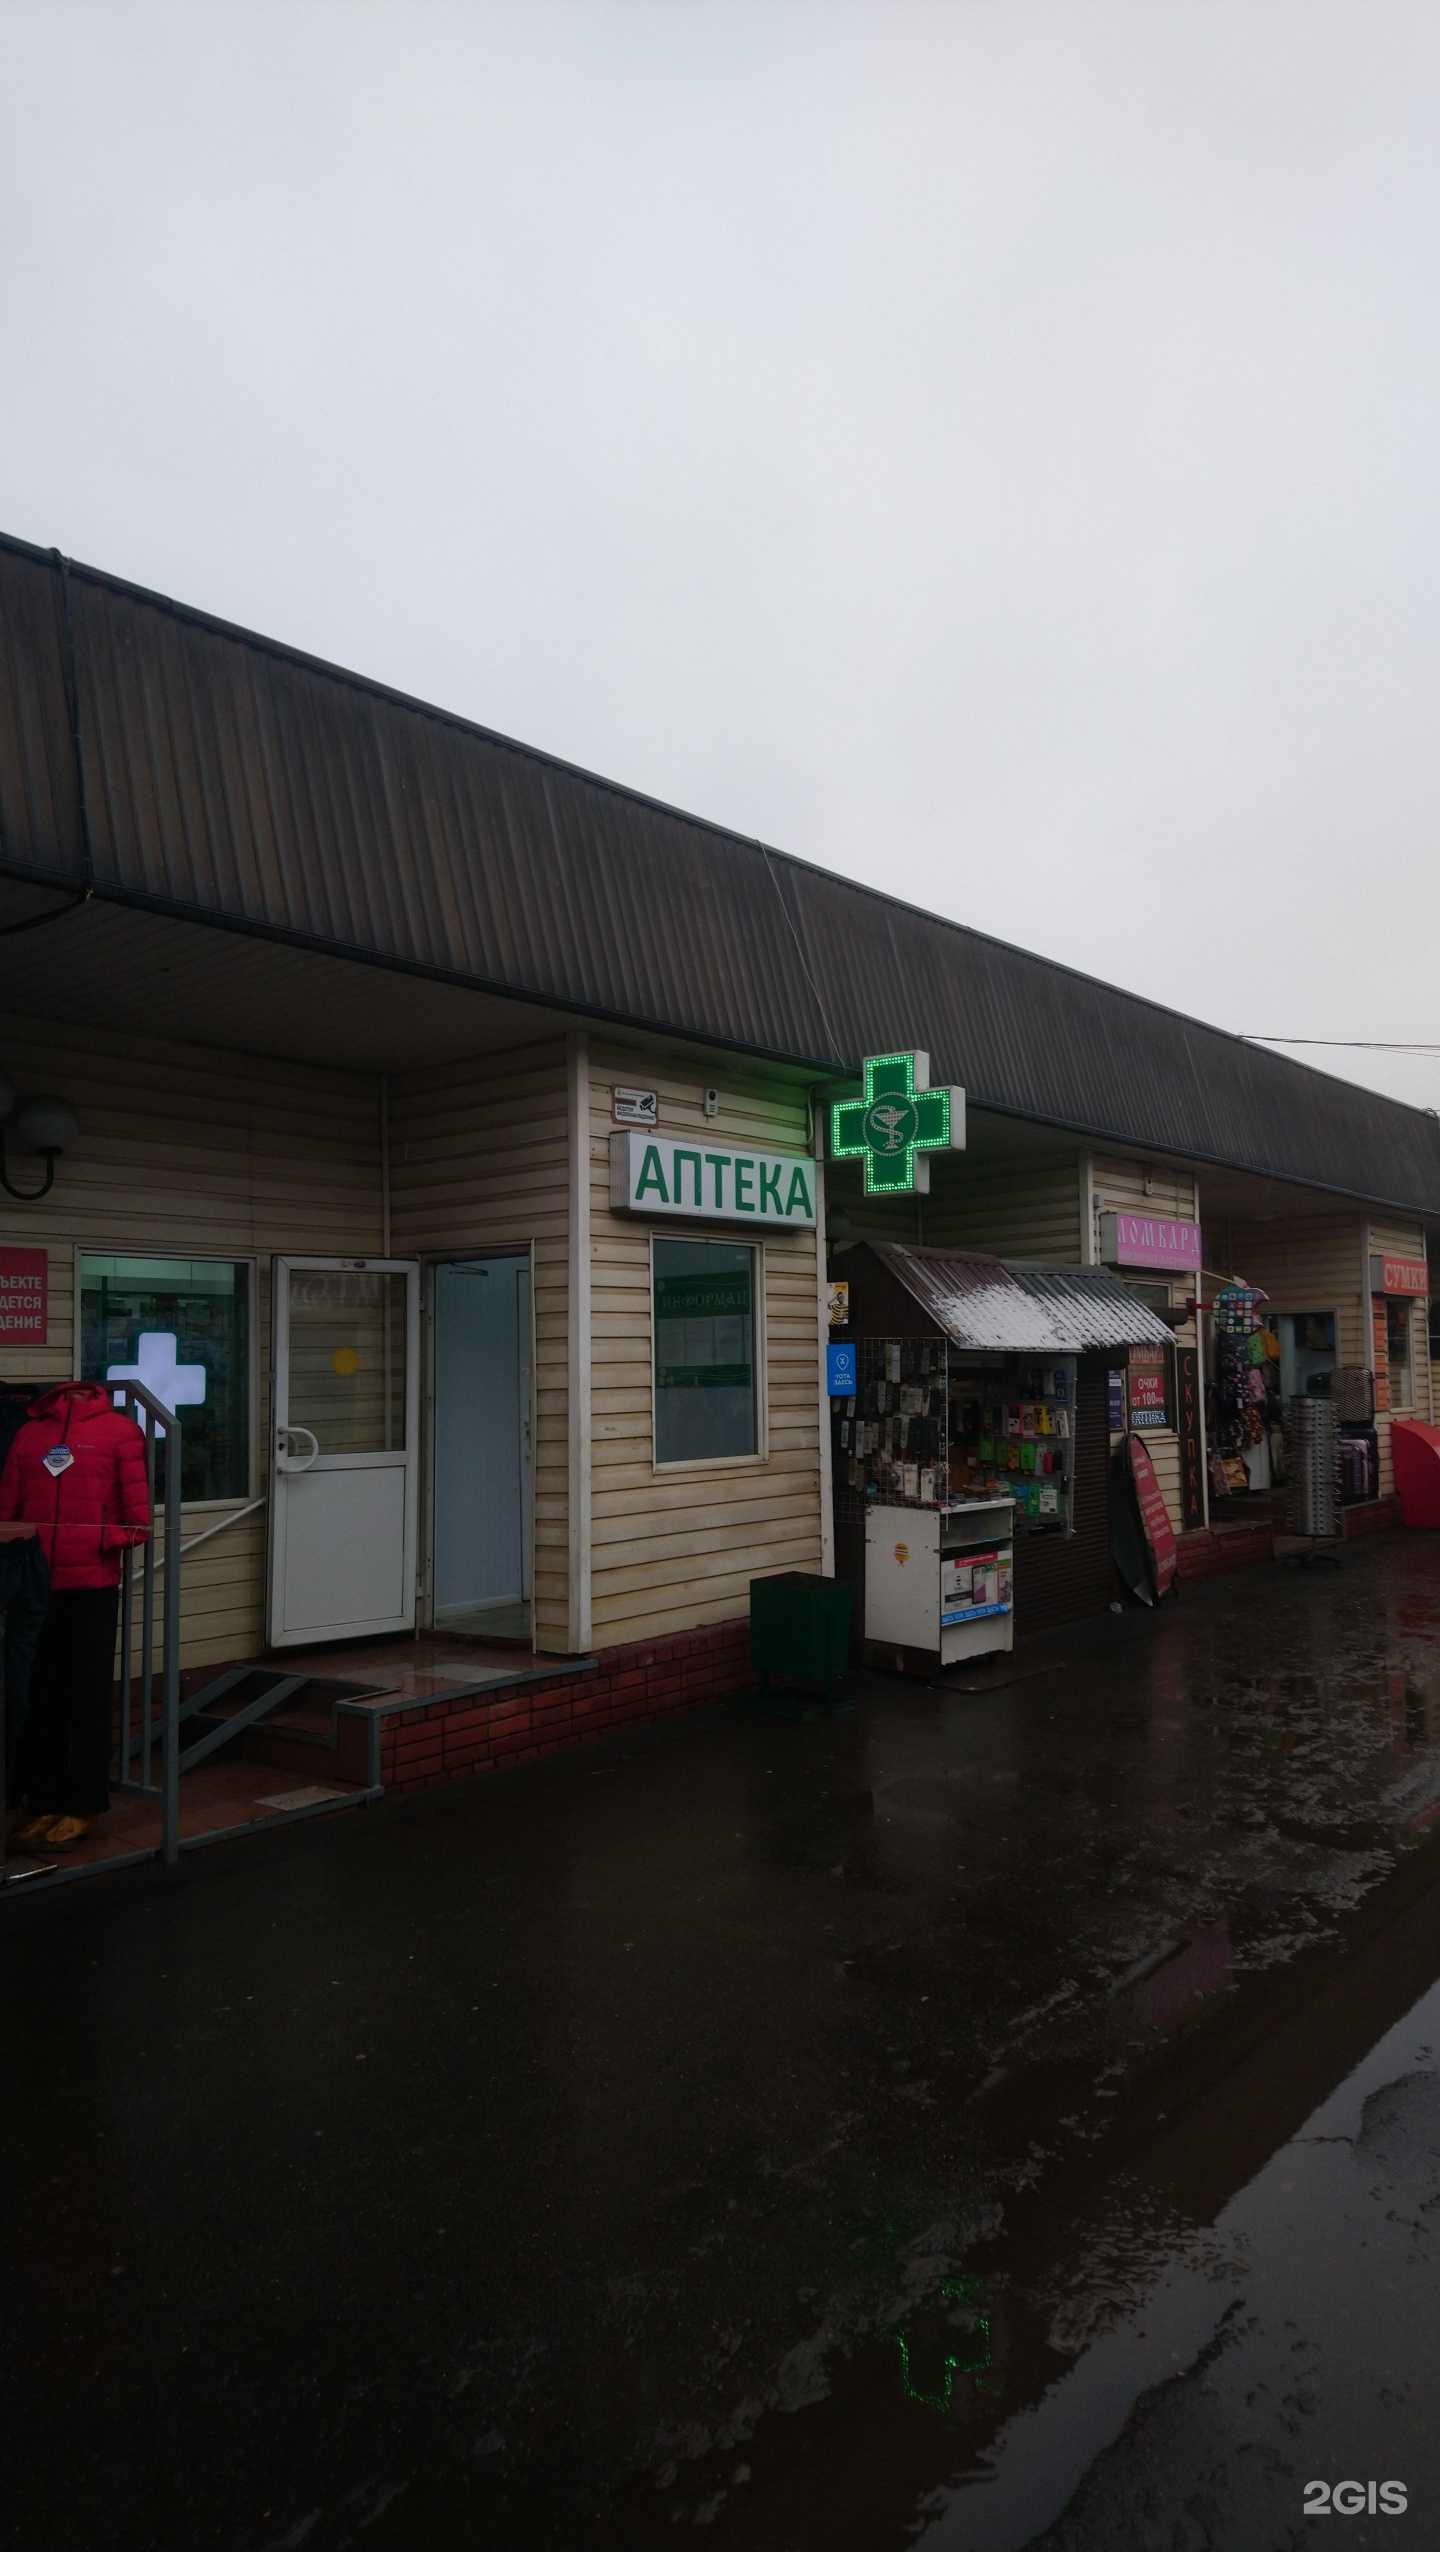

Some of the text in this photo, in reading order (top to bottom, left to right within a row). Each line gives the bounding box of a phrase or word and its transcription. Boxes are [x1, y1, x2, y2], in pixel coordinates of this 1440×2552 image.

[635, 1145, 813, 1218] АПТЕКА
[1118, 1217, 1200, 1255] ЛОМБАРД
[1384, 1263, 1426, 1289] СУМКИ
[1138, 1377, 1158, 1390] ОЧКИ
[1182, 1355, 1198, 1515] СКУПКА
